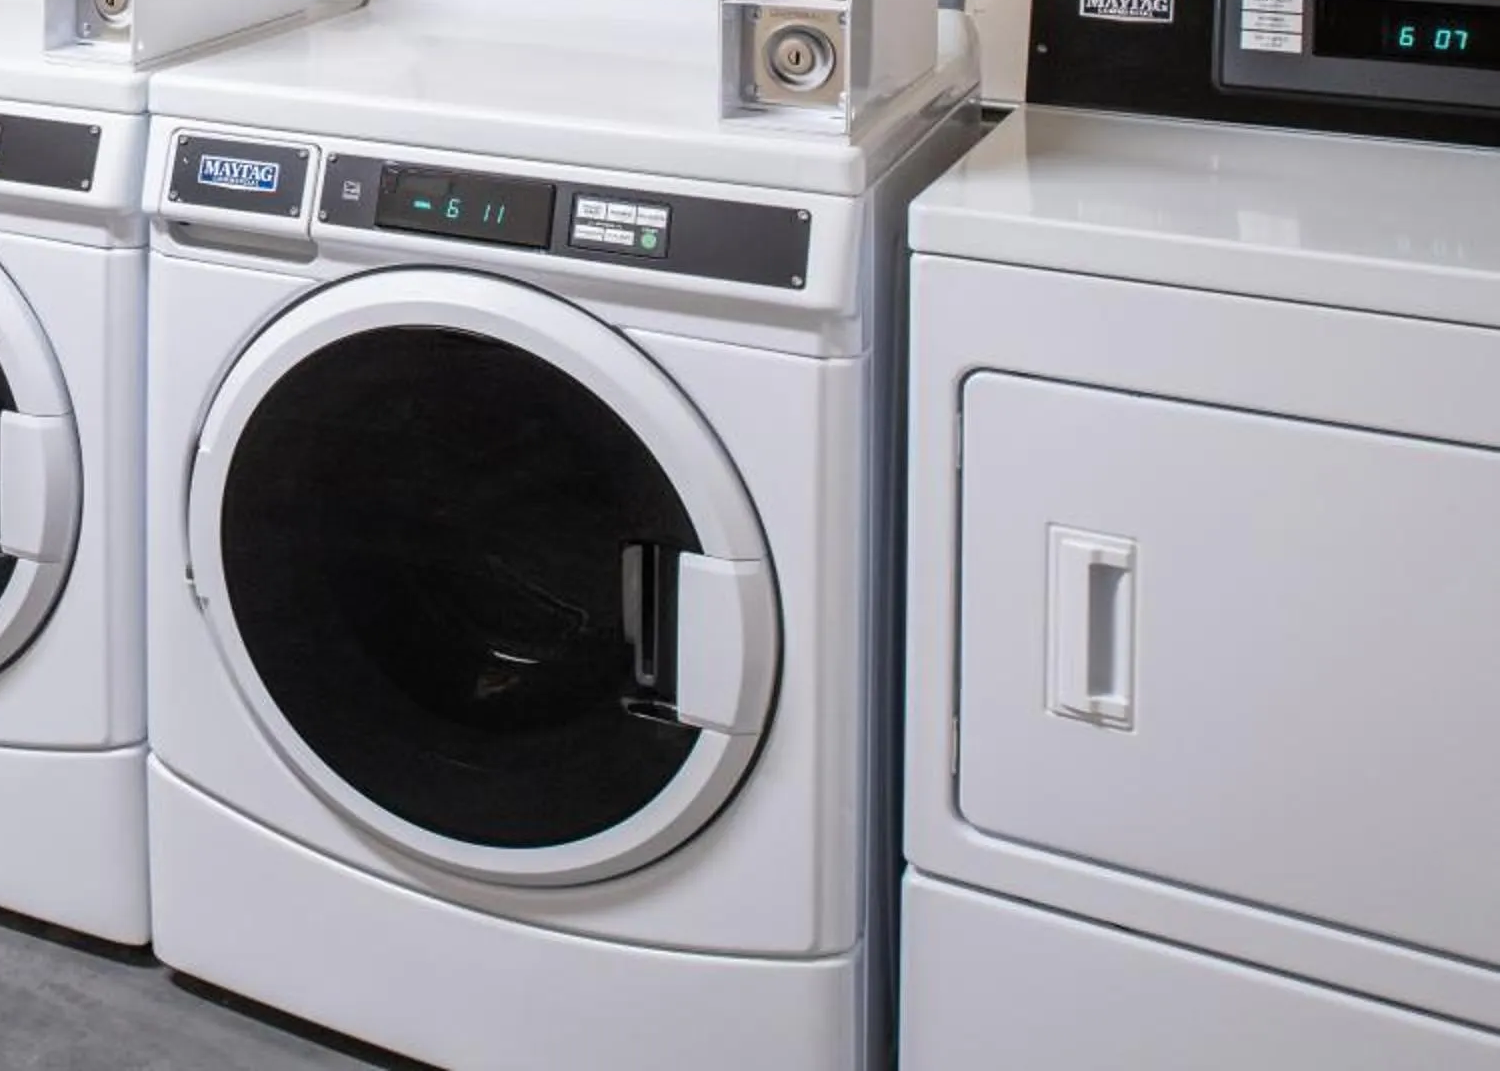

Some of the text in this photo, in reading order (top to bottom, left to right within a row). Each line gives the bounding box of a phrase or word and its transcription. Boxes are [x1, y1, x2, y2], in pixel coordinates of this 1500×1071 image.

[1399, 26, 1468, 50] 6 07
[203, 160, 273, 182] MAYTAG
